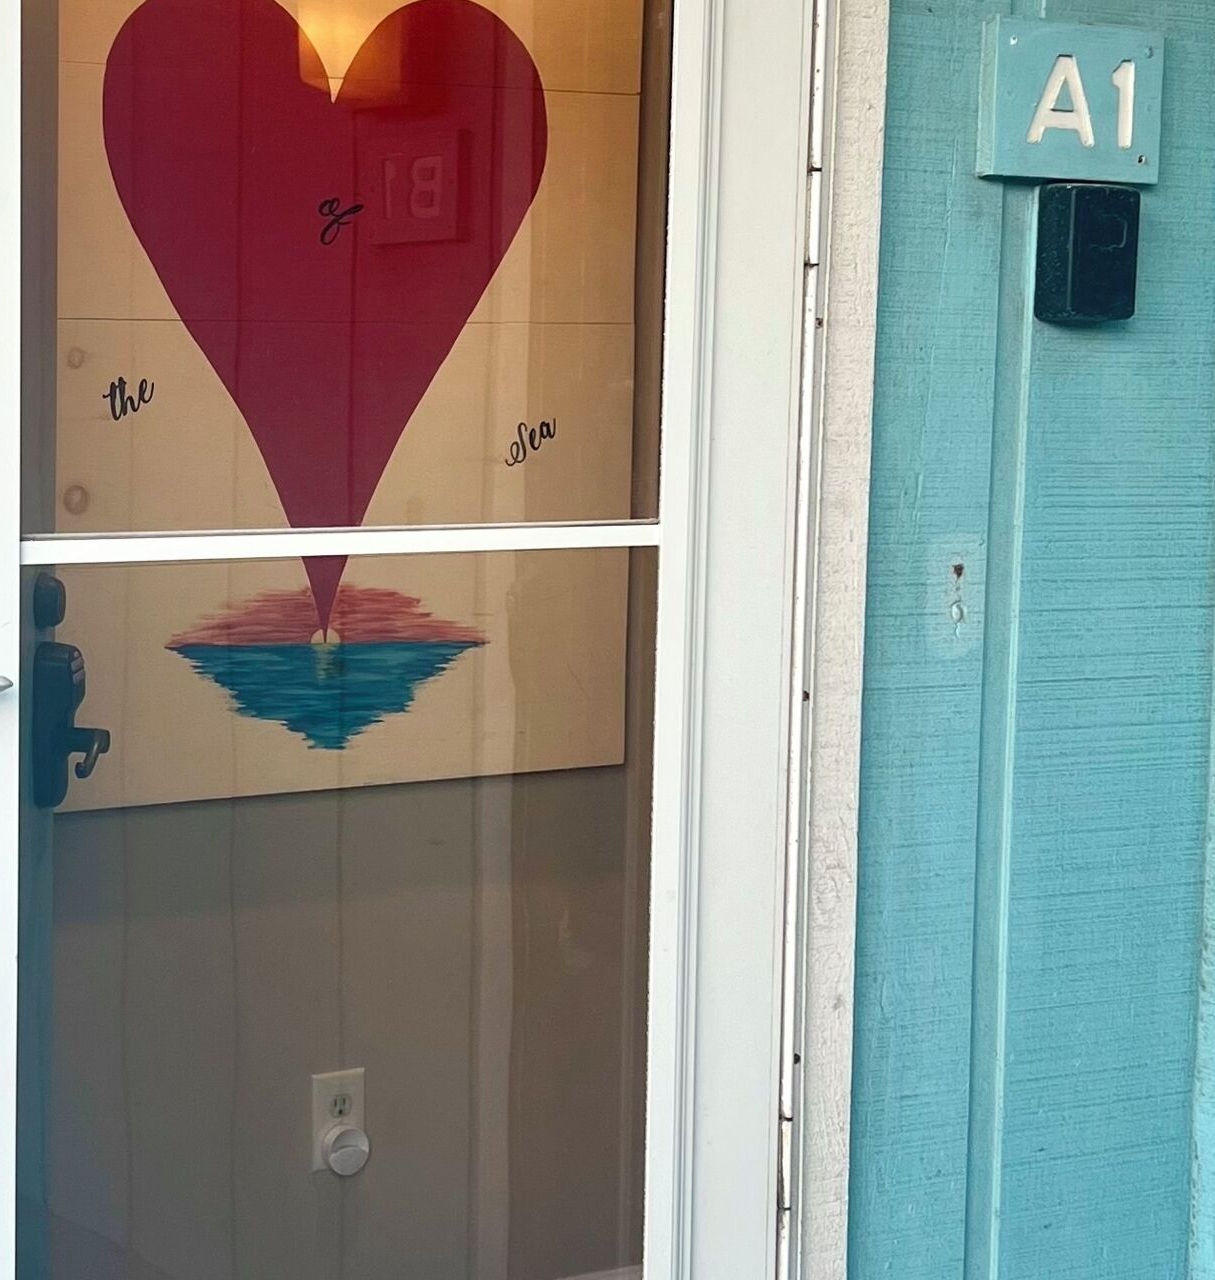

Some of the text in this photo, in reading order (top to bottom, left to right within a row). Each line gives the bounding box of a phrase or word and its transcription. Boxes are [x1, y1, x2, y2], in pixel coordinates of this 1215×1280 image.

[1026, 53, 1135, 149] A1
[318, 197, 364, 245] of
[102, 376, 154, 421] the
[505, 418, 556, 467] Sea
